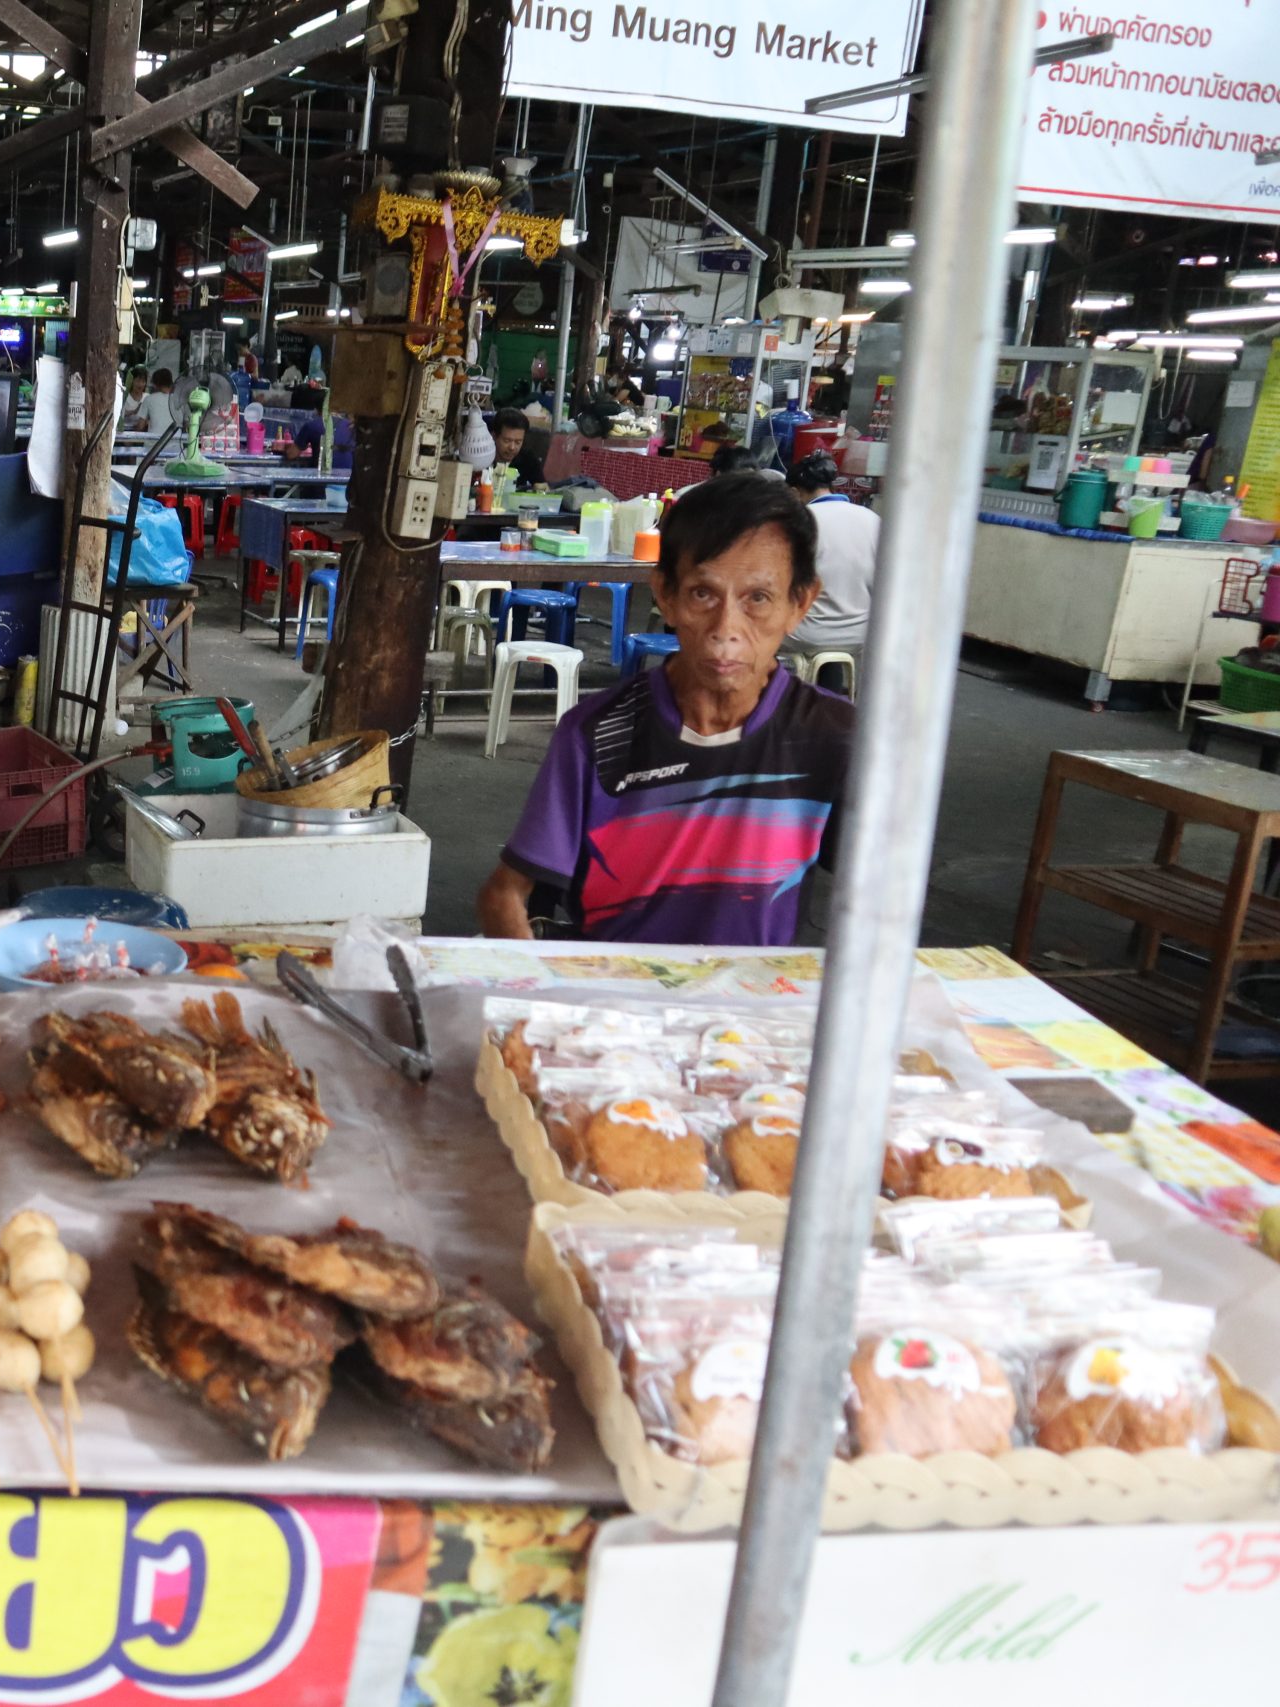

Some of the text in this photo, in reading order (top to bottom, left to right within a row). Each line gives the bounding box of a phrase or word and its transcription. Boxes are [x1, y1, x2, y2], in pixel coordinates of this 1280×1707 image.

[612, 5, 736, 58] Muang
[755, 22, 878, 68] Market
[1059, 6, 1212, 48] ผ่านจดคัดกรอง
[1183, 1530, 1280, 1595] 35
[848, 1581, 1102, 1666] Mild
